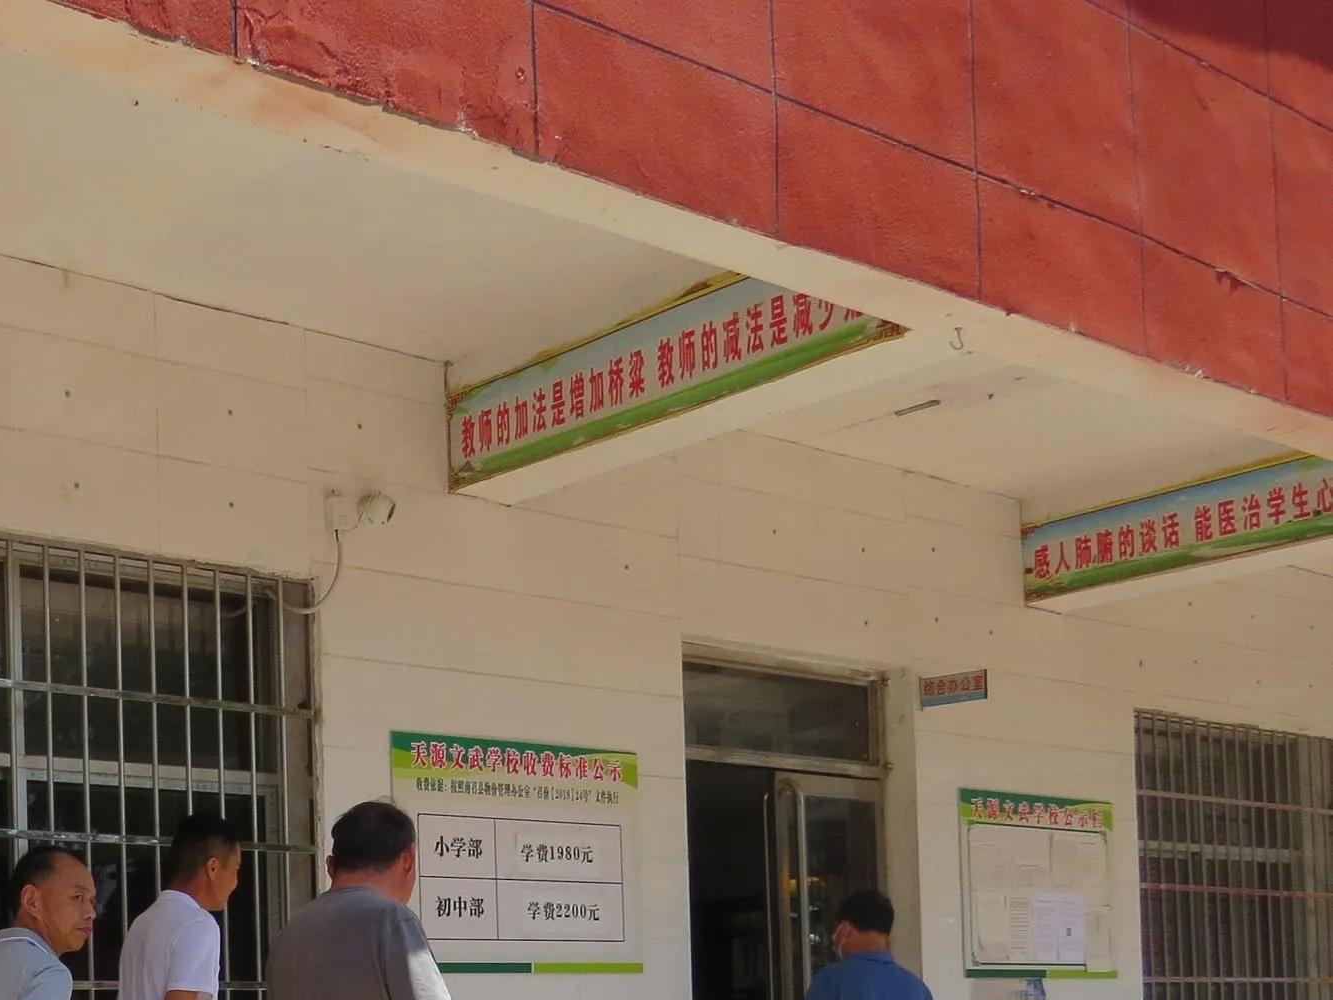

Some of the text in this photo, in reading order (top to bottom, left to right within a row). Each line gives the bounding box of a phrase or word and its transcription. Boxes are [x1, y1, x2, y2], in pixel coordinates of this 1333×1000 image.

[460, 350, 646, 459] 教师的加法是增加桥梁
[1033, 511, 1180, 580] 感人肺腑的谈话
[923, 675, 984, 696] 综合办公室
[410, 740, 623, 782] 天源文武学校收费标准公示
[971, 798, 1104, 828] 天源文武学校公示栏
[434, 836, 594, 864] 小学部 学费1980元
[435, 896, 601, 922] 初中部 学费2200元
